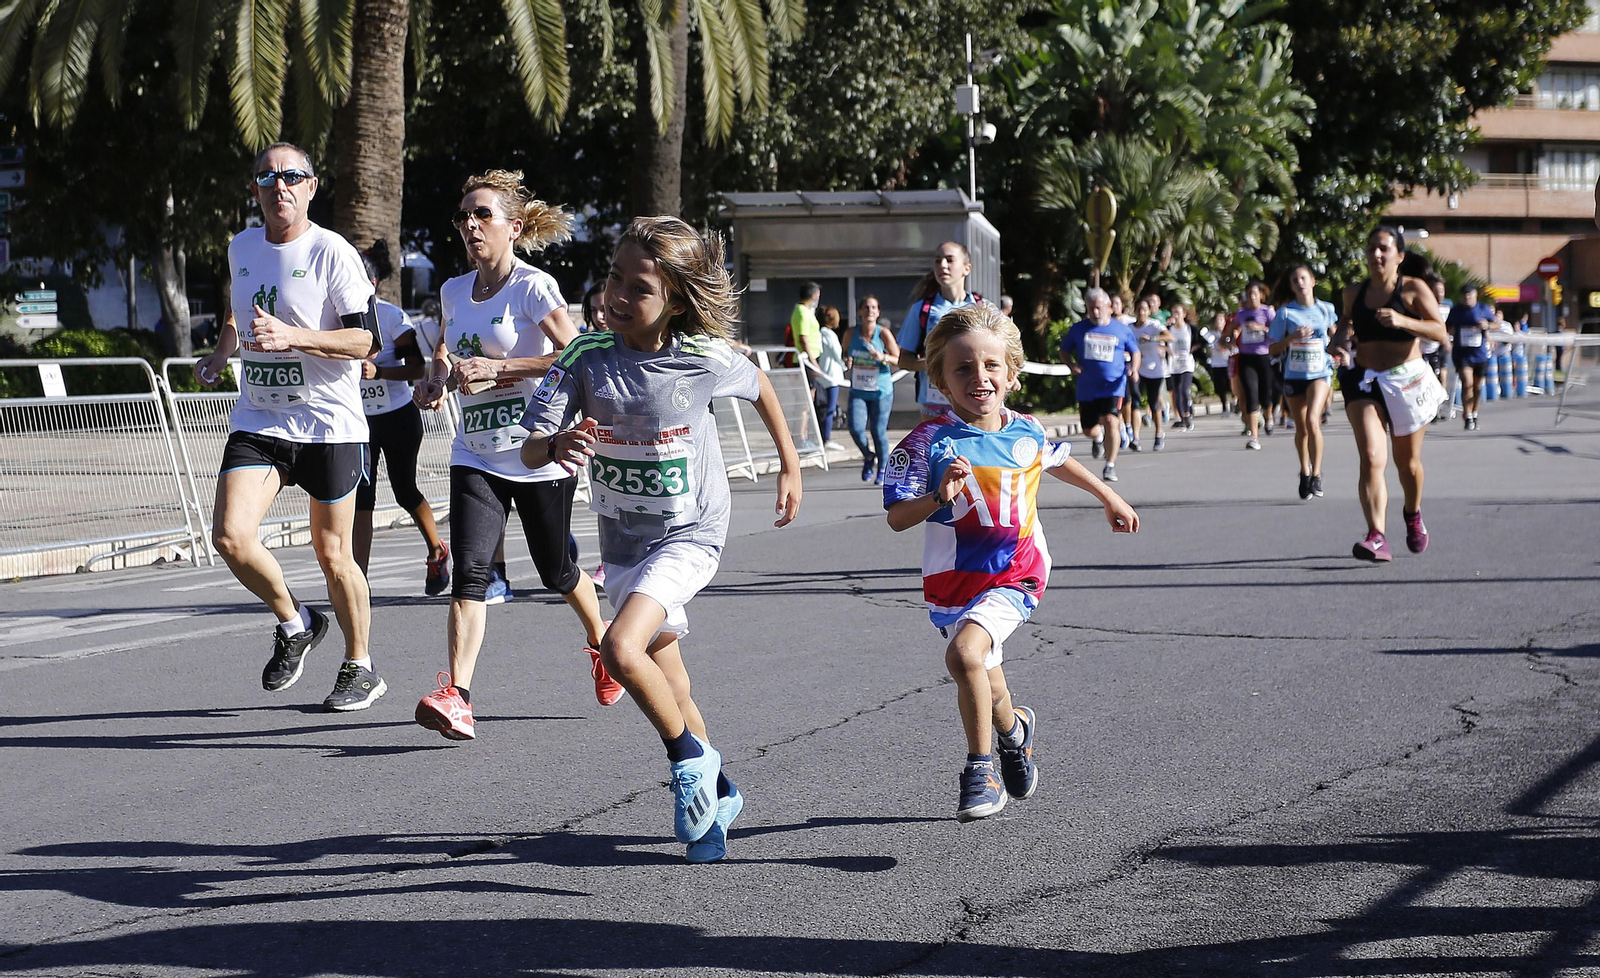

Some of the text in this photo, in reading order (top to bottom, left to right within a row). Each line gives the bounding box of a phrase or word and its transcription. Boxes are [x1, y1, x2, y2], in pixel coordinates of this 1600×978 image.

[245, 365, 302, 386] 22766
[536, 389, 549, 398] LFP
[465, 403, 524, 433] 22765
[659, 448, 685, 457] CARRERA
[593, 458, 685, 496] 22533
